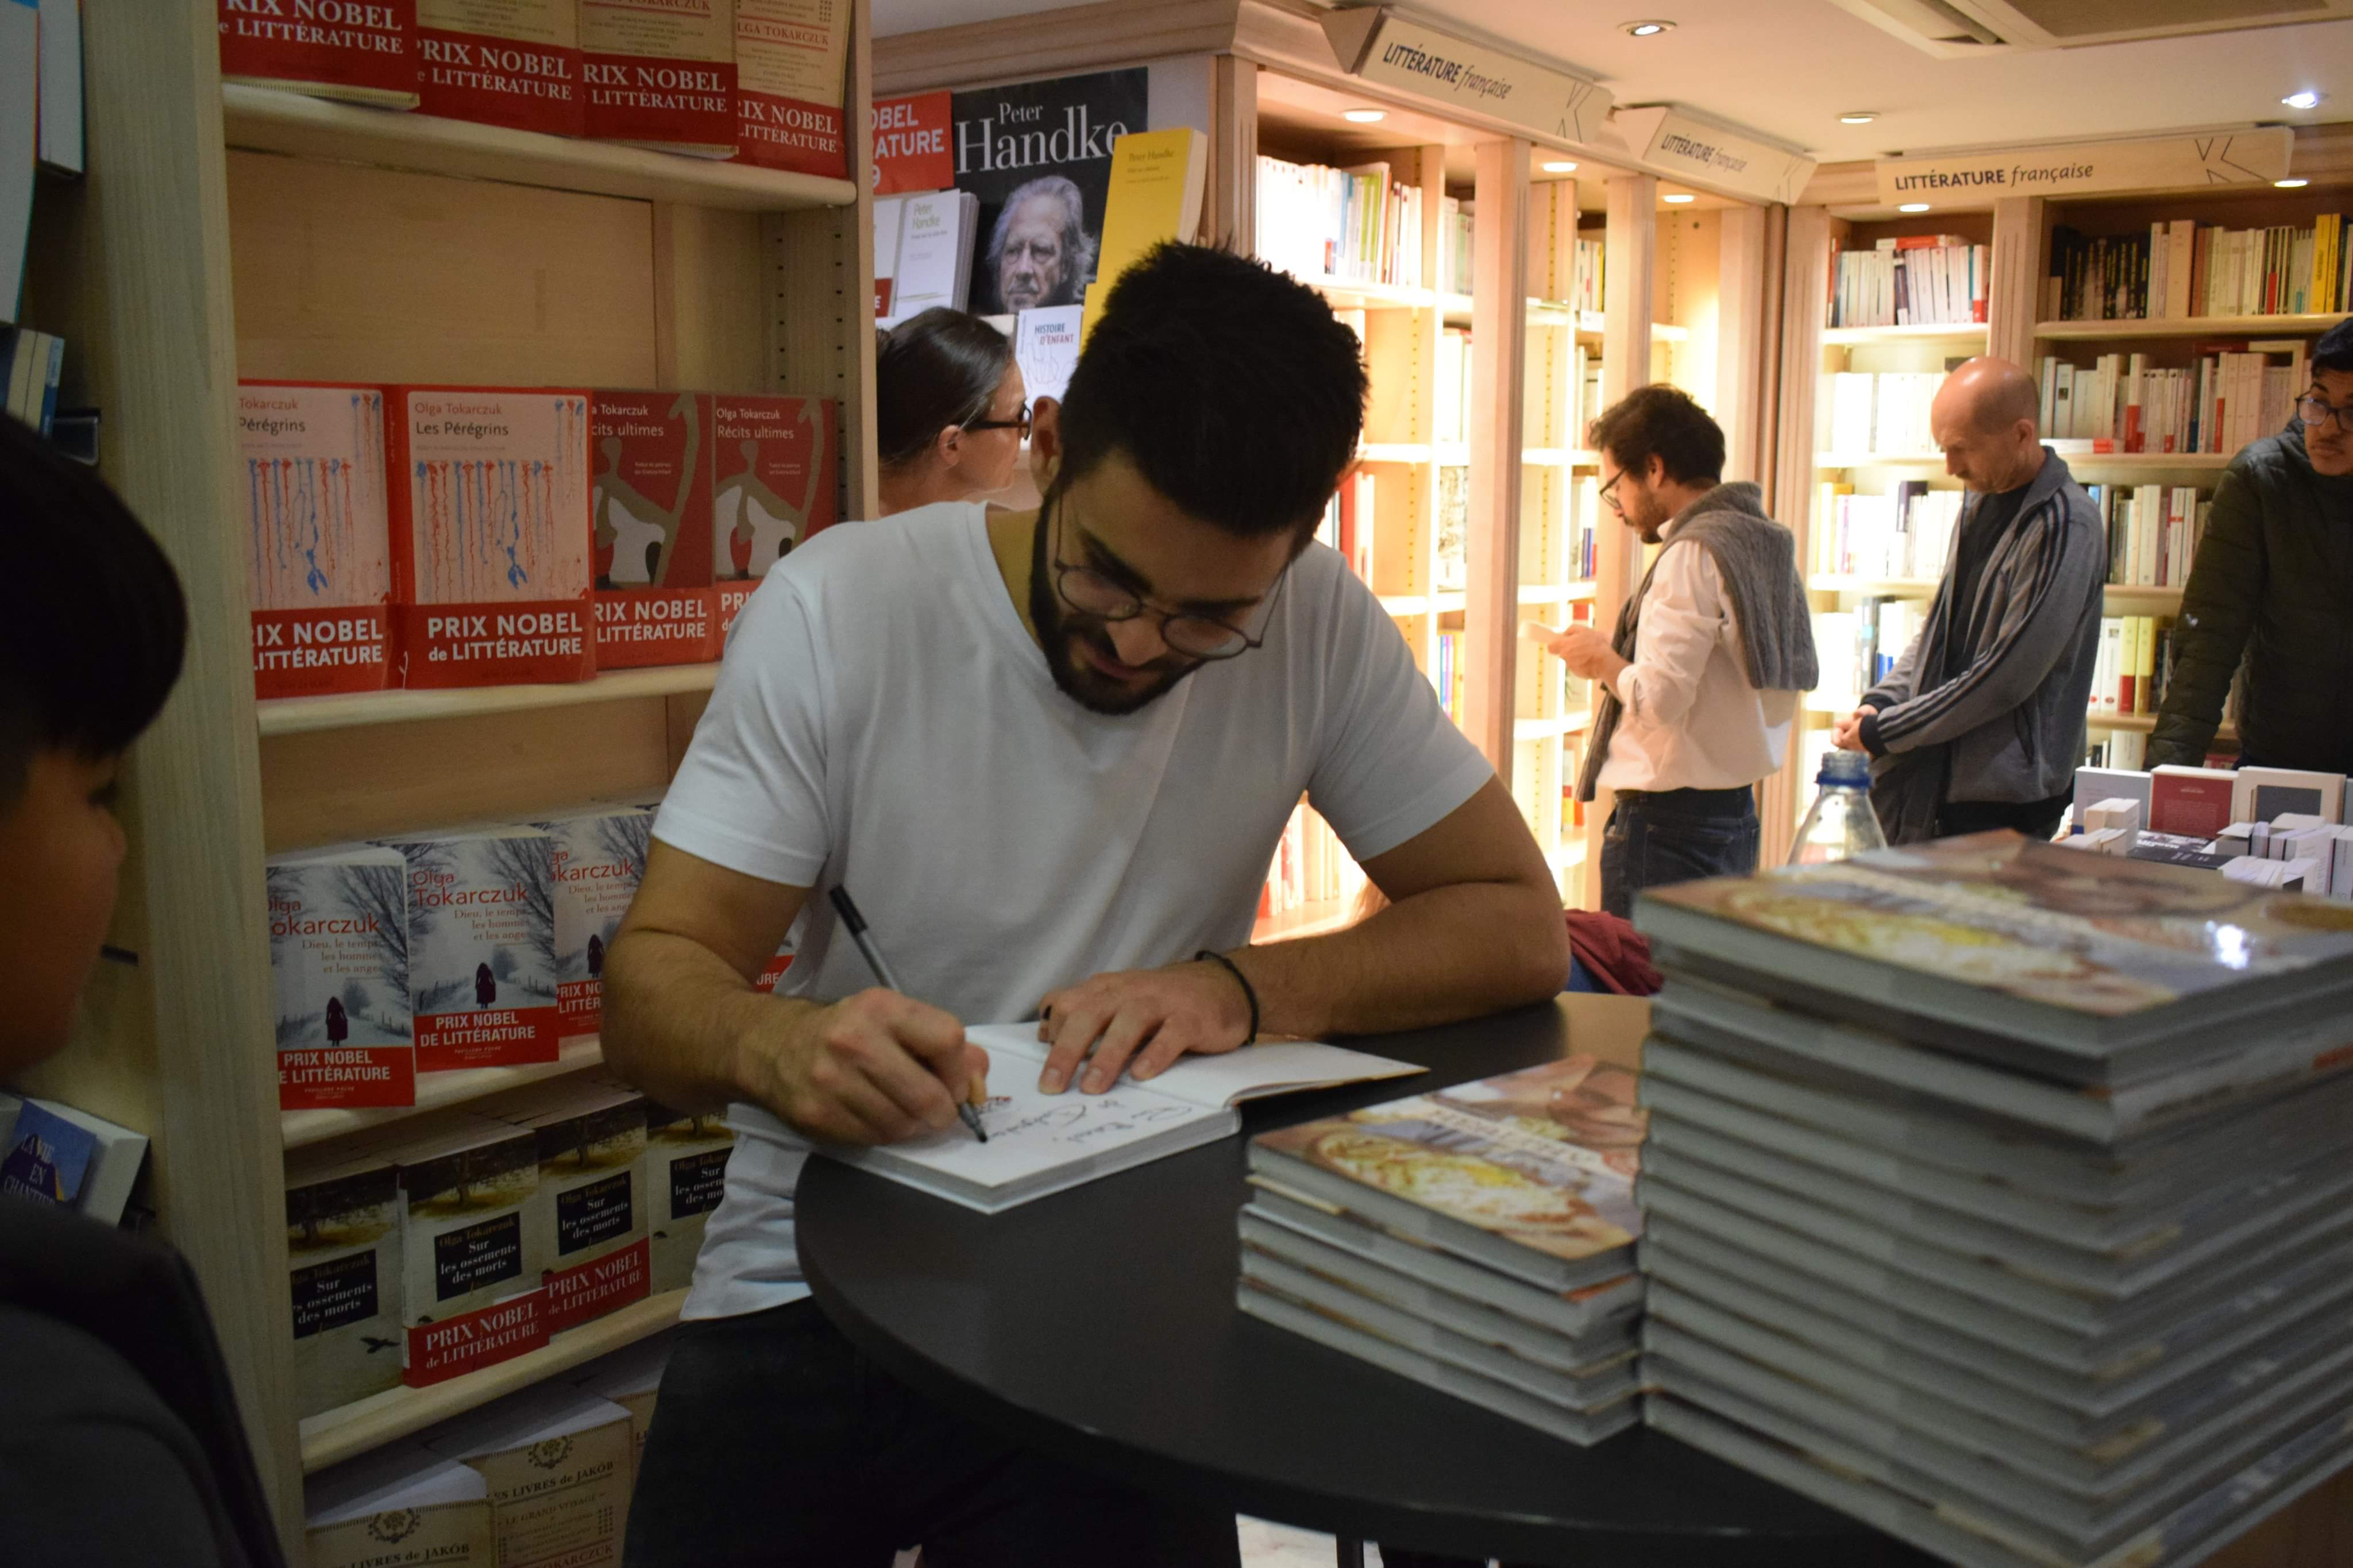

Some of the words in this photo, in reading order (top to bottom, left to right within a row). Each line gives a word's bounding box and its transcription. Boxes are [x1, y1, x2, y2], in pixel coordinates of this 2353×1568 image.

[294, 0, 402, 31] NOBEL
[218, 21, 229, 34] e
[237, 18, 403, 54] LITTÉRATURE
[737, 21, 761, 34] LGA
[764, 25, 828, 46] TOKARCZUK
[416, 38, 472, 65] RIX
[481, 47, 571, 79] NOBEL
[583, 63, 629, 86] RIX
[636, 67, 726, 92] NOBEL
[1382, 41, 1463, 84] LITTÉRATURE
[1453, 64, 1513, 100] française
[433, 68, 572, 101] LITTÉRATURE
[591, 88, 727, 113] LITTÉRATURE
[771, 105, 837, 135] NOBEL
[1000, 102, 1043, 125] Peter
[738, 123, 837, 154] ITTÉRATURE
[955, 104, 1128, 173] Handke
[1660, 133, 1716, 163] LITTÉRATURE
[1895, 168, 2006, 191] LITTÉRATURE
[2011, 163, 2094, 188] française
[1035, 322, 1066, 334] HISTOIRE
[1040, 334, 1074, 345] D'ENFANT
[239, 398, 298, 410] Tokarczuk
[415, 402, 442, 417] Olga
[445, 403, 502, 415] Tokarczuk
[600, 404, 648, 416] Tokarczuk
[716, 407, 737, 422] Olga
[739, 408, 781, 420] Tokarczuk
[416, 422, 439, 435] Les
[444, 421, 509, 440] Pérégrins
[592, 423, 613, 436] cits
[618, 421, 664, 437] ultimes
[718, 424, 751, 438] Récits
[754, 425, 794, 439] ultimes
[595, 602, 627, 622] RIX
[635, 599, 707, 621] NOBEL
[257, 624, 283, 647] IX
[294, 619, 383, 644] NOBEL
[428, 616, 487, 639] PRIX
[497, 612, 583, 636] NOBEL
[597, 622, 706, 643] LITTÉRATURE
[253, 644, 383, 670] ITTÉRATURE
[429, 646, 448, 661] de
[453, 637, 582, 661] LITTÉRATURE
[551, 851, 568, 866] ga
[551, 857, 634, 882] karczuk
[412, 871, 454, 887] Olga
[414, 882, 529, 907] Tokarczuk
[268, 897, 301, 916] lga
[272, 912, 379, 936] okarczuk
[559, 995, 601, 1014] LITTÉR
[435, 1015, 469, 1030] PRIX
[473, 1011, 519, 1026] NOBEL
[421, 1033, 439, 1048] DE
[443, 1026, 536, 1045] LITTÉRATURE
[284, 1052, 319, 1067] PRIX
[325, 1050, 373, 1065] NOBEL
[279, 1071, 288, 1084] E
[292, 1065, 391, 1084] LITTÉRATURE
[701, 1168, 720, 1178] Sur
[676, 1185, 689, 1195] les
[693, 1178, 724, 1191] ossem
[588, 1198, 605, 1210] Sur
[686, 1194, 703, 1204] des
[563, 1219, 576, 1230] les
[580, 1202, 628, 1224] ossements
[573, 1227, 589, 1238] des
[593, 1216, 620, 1231] morts
[469, 1241, 489, 1253] Sur
[441, 1262, 457, 1275] les
[461, 1244, 516, 1268] ossements
[453, 1271, 472, 1284] des
[475, 1260, 507, 1276] morts
[549, 1270, 589, 1297] PRIX
[595, 1251, 642, 1283] NOBEL
[307, 1283, 372, 1308] ossements
[317, 1279, 340, 1293] Sur
[548, 1304, 561, 1315] de
[564, 1269, 643, 1311] LITTÉRATURE
[298, 1311, 319, 1324] des
[325, 1300, 361, 1317] morts
[427, 1322, 473, 1351] PRIX
[480, 1303, 538, 1332] NOBEL
[426, 1358, 440, 1369] de
[443, 1321, 539, 1364] LITTÉRATURE
[512, 1478, 556, 1497] LIVRES
[560, 1475, 573, 1485] de
[405, 1551, 420, 1561] de
